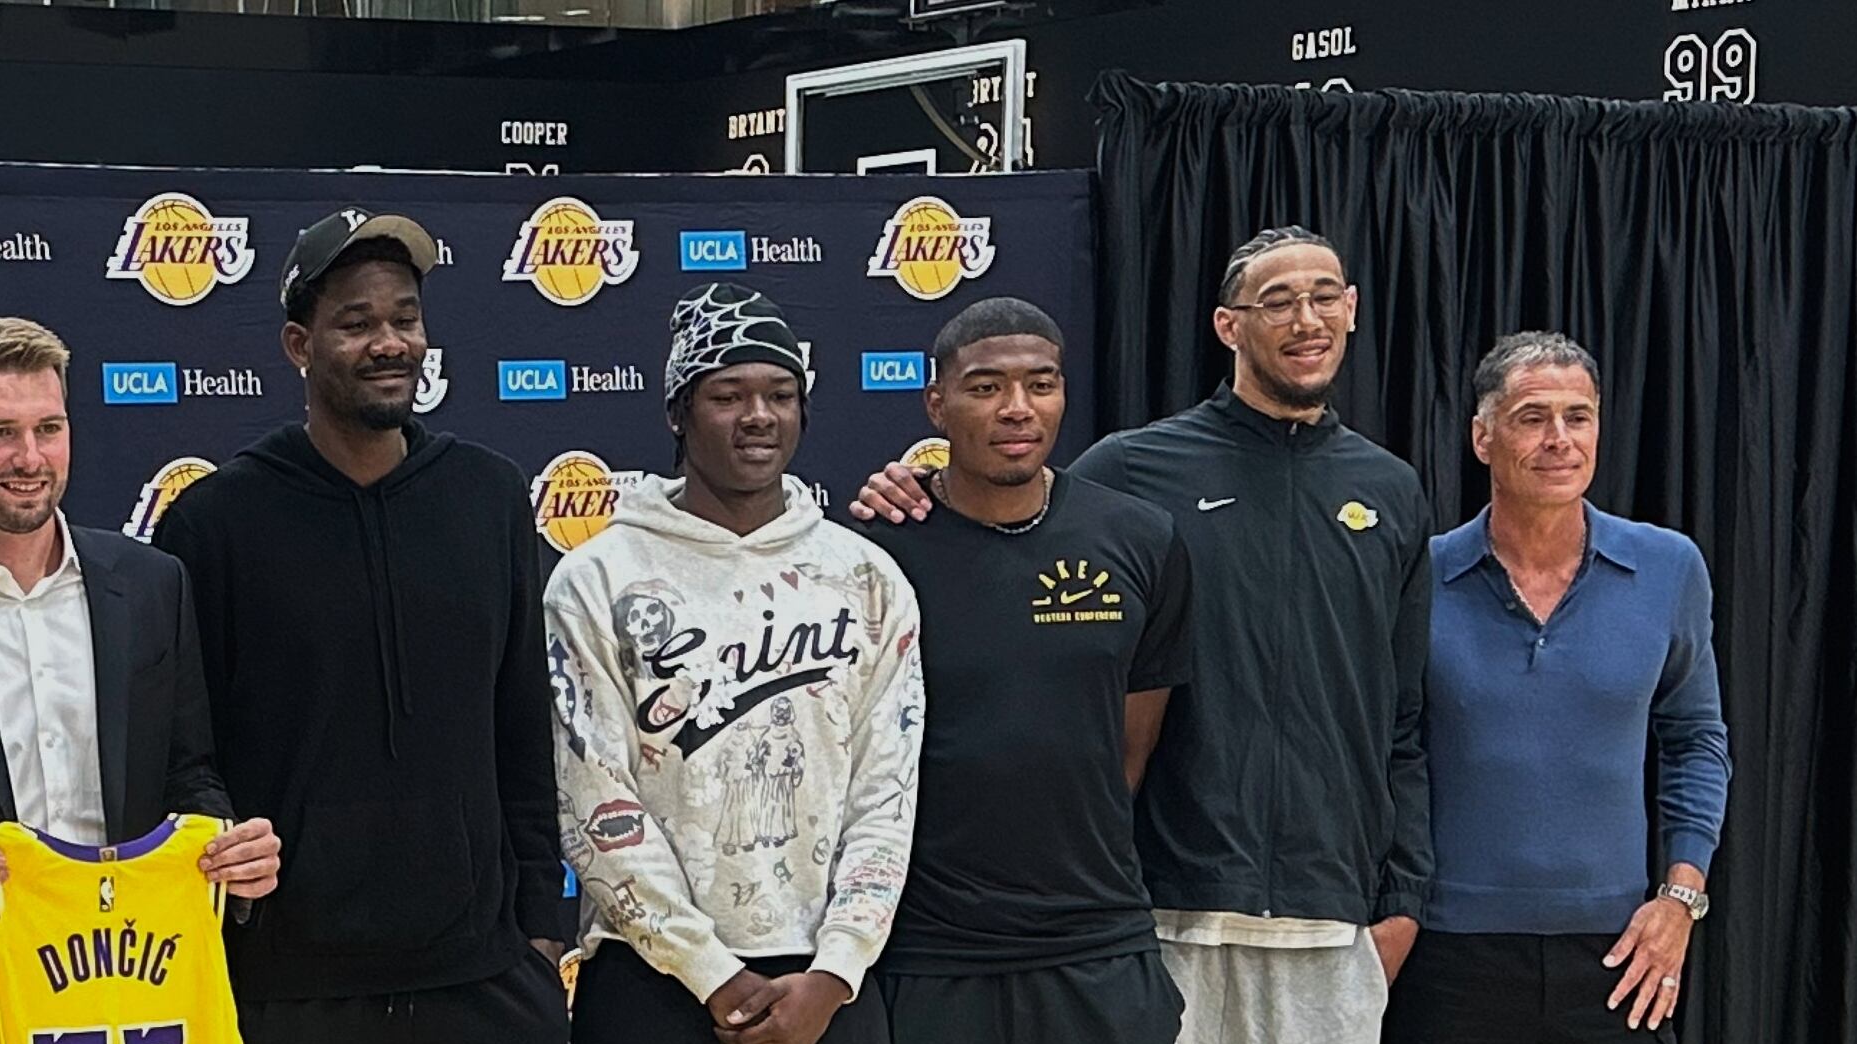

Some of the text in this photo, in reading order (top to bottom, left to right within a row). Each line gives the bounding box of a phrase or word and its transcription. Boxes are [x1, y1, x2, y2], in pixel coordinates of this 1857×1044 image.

[1292, 27, 1355, 60] GASOL
[1663, 28, 1756, 104] 99
[501, 121, 568, 145] COOPER
[728, 109, 785, 139] BRYANT
[155, 221, 241, 232] LOS ANGELES
[547, 224, 626, 234] LOS ANGELES
[909, 221, 984, 231] LOS ANGELES
[121, 222, 239, 272] LAKERS
[515, 226, 623, 273] LAKERS
[689, 237, 821, 262] UCLA Health
[880, 224, 982, 270] LAKERS
[114, 369, 262, 395] UCLA Health
[507, 366, 644, 391] UCLA Health
[871, 360, 916, 381] UCLA
[559, 475, 638, 488] LOS ANGELES
[535, 480, 620, 526] LAKER
[37, 919, 182, 993] DONČIĆ
